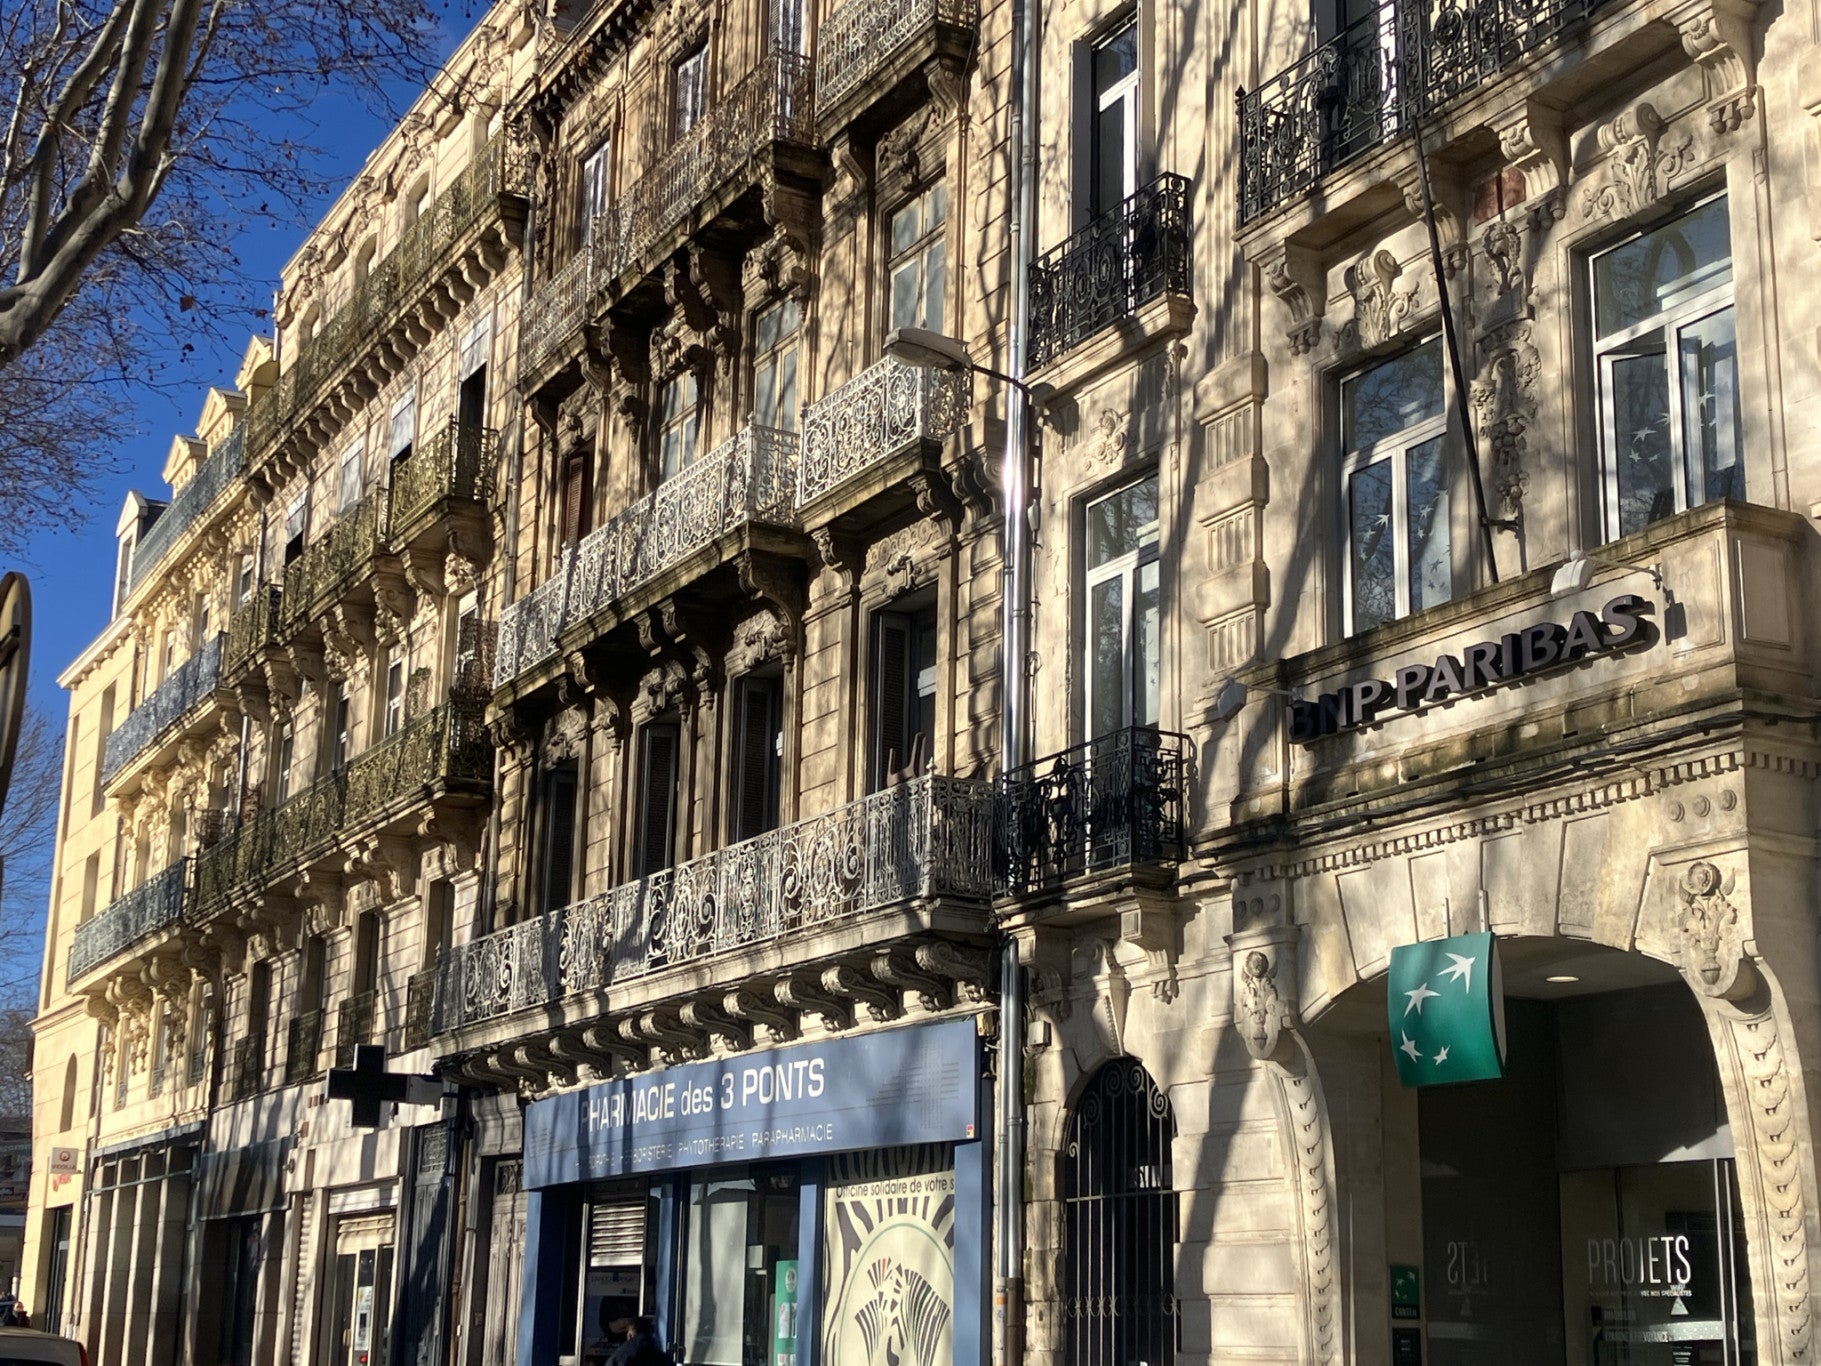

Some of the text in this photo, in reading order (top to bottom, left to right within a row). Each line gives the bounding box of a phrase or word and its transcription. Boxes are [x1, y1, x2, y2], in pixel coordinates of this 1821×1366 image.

[1286, 594, 1652, 744] BNP PARIBAS
[580, 1057, 825, 1133] PHARMACIE des 3 PONTS
[751, 1123, 834, 1147] PARAPHARMACIE
[836, 1184, 869, 1199] Officine
[870, 1180, 908, 1197] solidaire
[909, 1177, 923, 1194] de
[925, 1175, 951, 1192] votre
[1587, 1235, 1692, 1284] PROJETS
